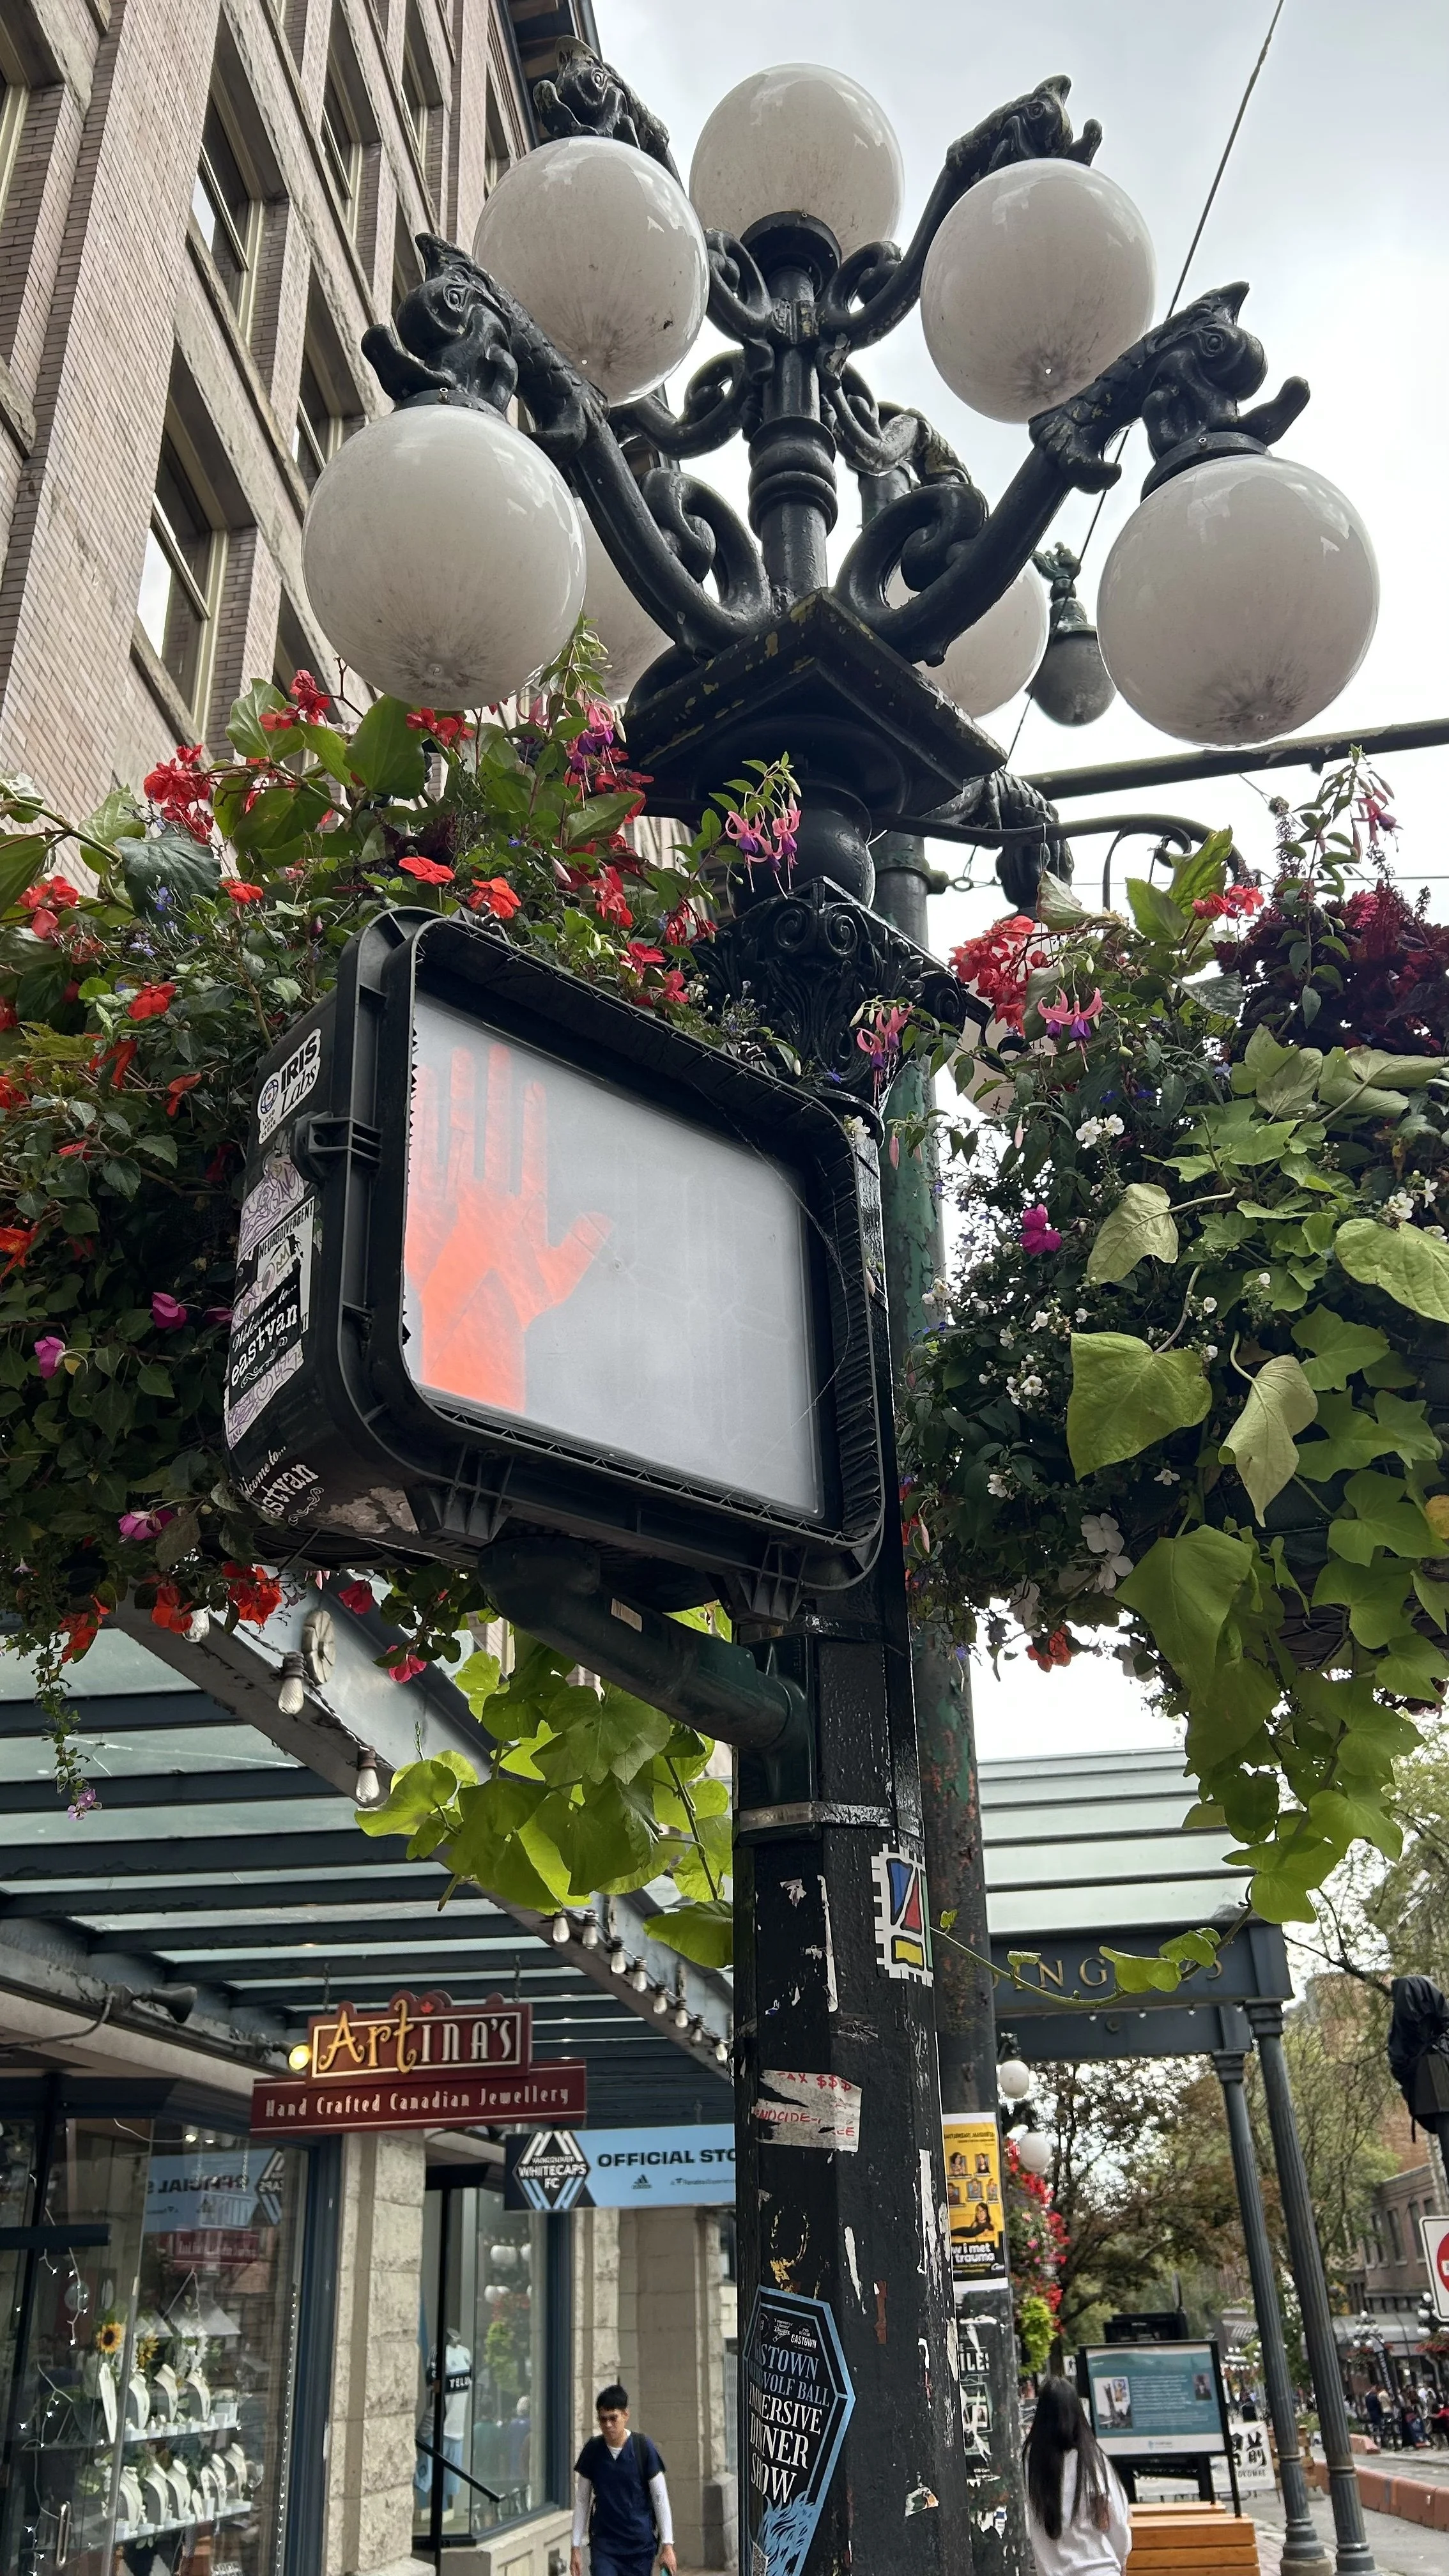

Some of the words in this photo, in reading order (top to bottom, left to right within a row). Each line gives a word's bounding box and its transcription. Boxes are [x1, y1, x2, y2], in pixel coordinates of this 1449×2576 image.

[281, 1036, 318, 1093] IRIS
[280, 1064, 317, 1118] Labs
[231, 1304, 298, 1386] eastvan
[265, 2097, 307, 2117] Hand
[316, 2093, 381, 2115] Crafted
[390, 2090, 470, 2111] Canadian
[480, 2085, 569, 2106] Jewellery
[518, 2163, 587, 2177] WHITECAPS
[598, 2150, 694, 2168] OFFICIAL
[700, 2148, 736, 2163] STO
[544, 2177, 560, 2189] FC
[791, 2334, 816, 2349] GASTOWN
[749, 2382, 822, 2435] IMMERSIVE
[797, 2381, 829, 2407] BALL
[750, 2412, 809, 2469] DINNER
[751, 2453, 797, 2503] SHOW
